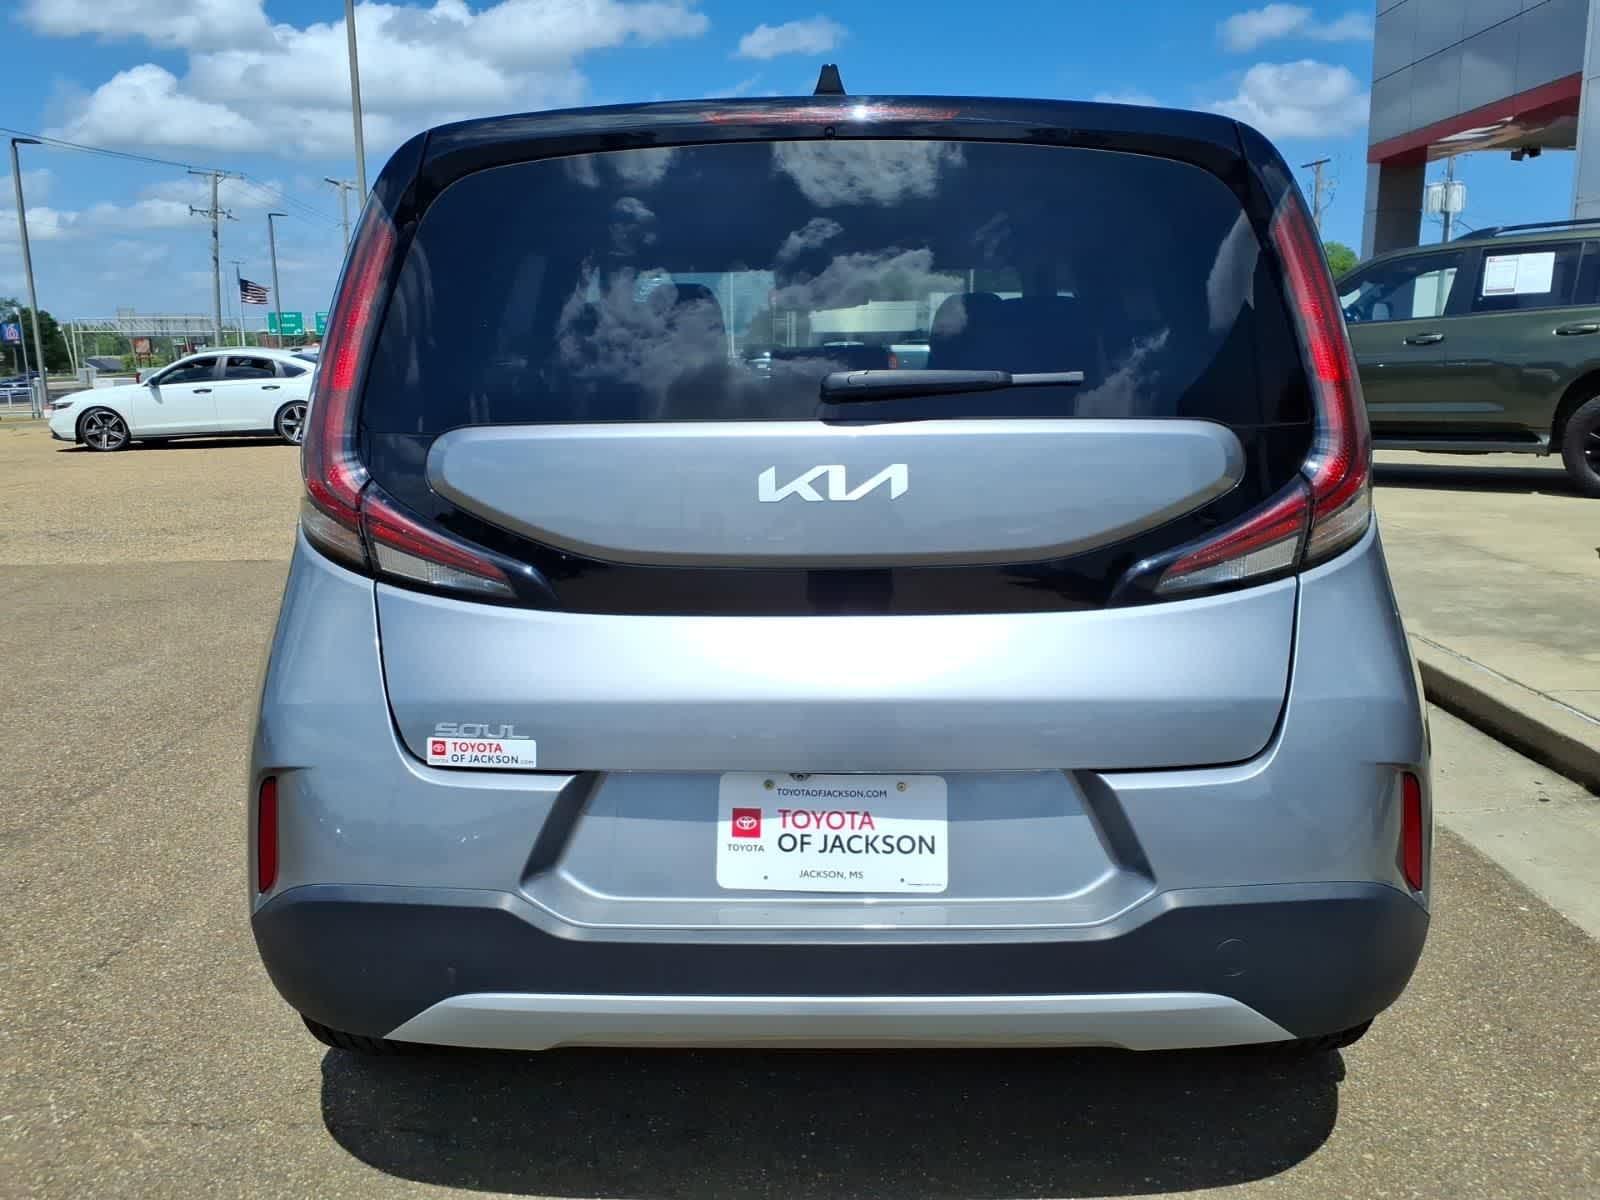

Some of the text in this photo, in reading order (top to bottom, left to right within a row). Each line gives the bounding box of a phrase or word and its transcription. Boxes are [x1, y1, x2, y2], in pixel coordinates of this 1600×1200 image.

[758, 463, 909, 502] KIA
[434, 722, 530, 740] SOUL
[452, 742, 503, 753] TOYOTA
[451, 754, 466, 763] OF
[468, 754, 519, 765] JACKSON
[777, 788, 888, 799] TOYOTAOFJACKSON.COM
[777, 809, 875, 831] TOYOTA
[727, 843, 765, 852] TOYOTA
[777, 833, 936, 855] OF JACKSON
[799, 870, 864, 880] JACKSON, MS
